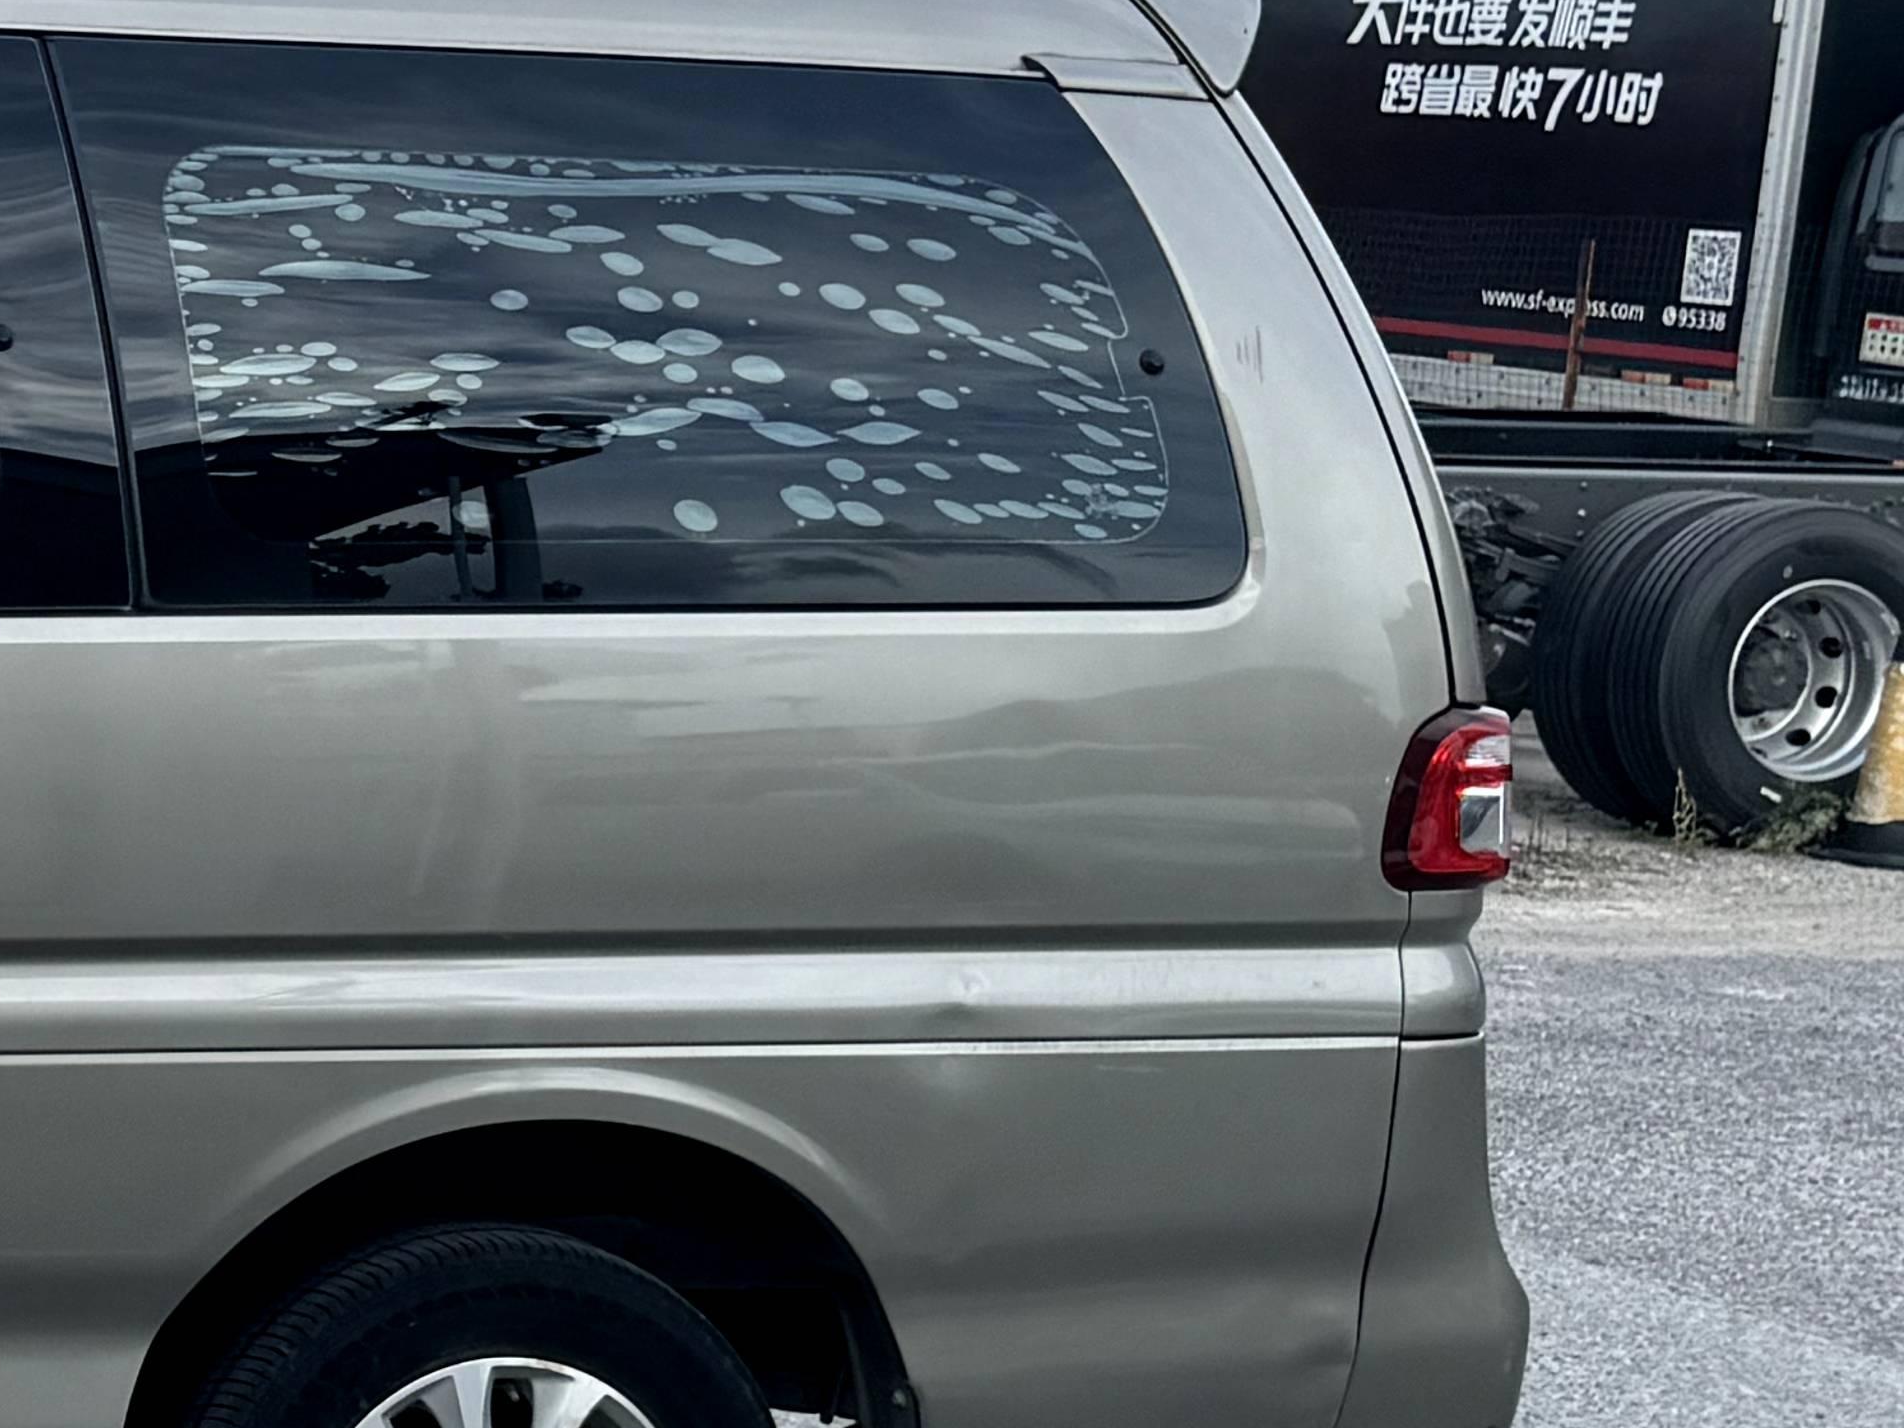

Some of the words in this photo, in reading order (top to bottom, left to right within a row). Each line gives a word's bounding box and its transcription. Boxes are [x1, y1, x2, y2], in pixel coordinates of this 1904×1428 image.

[1379, 62, 1664, 132] 跨省最快7小时
[1481, 288, 1645, 322] www.sf-expss.com
